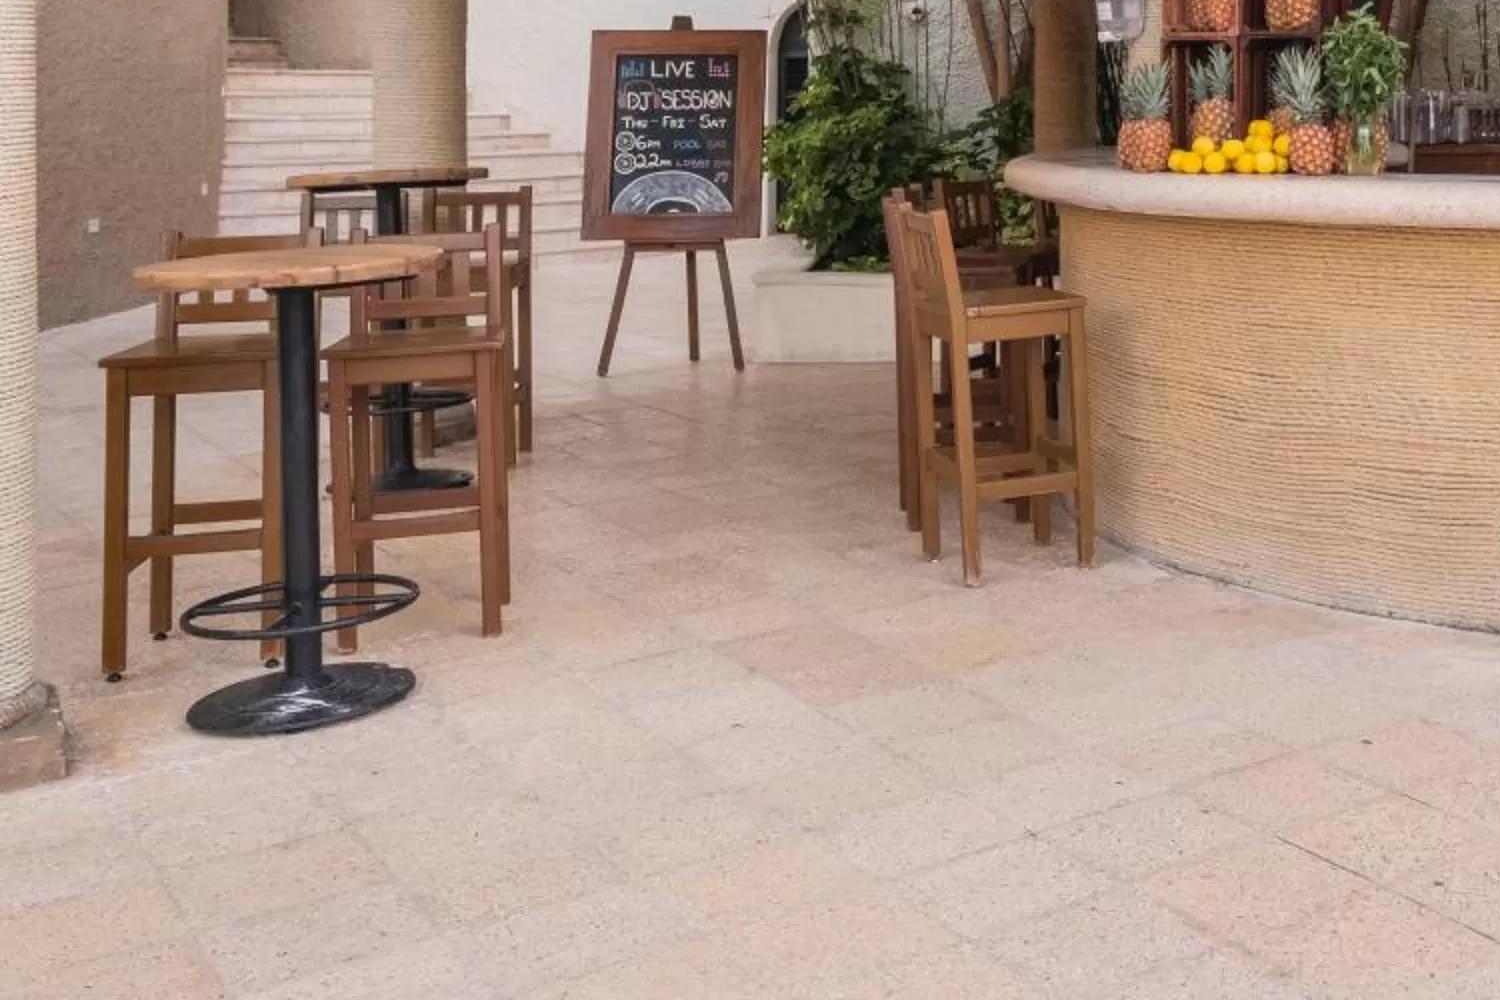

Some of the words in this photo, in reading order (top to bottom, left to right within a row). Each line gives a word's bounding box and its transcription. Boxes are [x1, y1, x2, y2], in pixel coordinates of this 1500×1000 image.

[651, 60, 695, 78] LIVE
[627, 91, 652, 111] DJ
[662, 115, 686, 129] FRI
[699, 113, 727, 129] SAT
[673, 139, 701, 149] POOL
